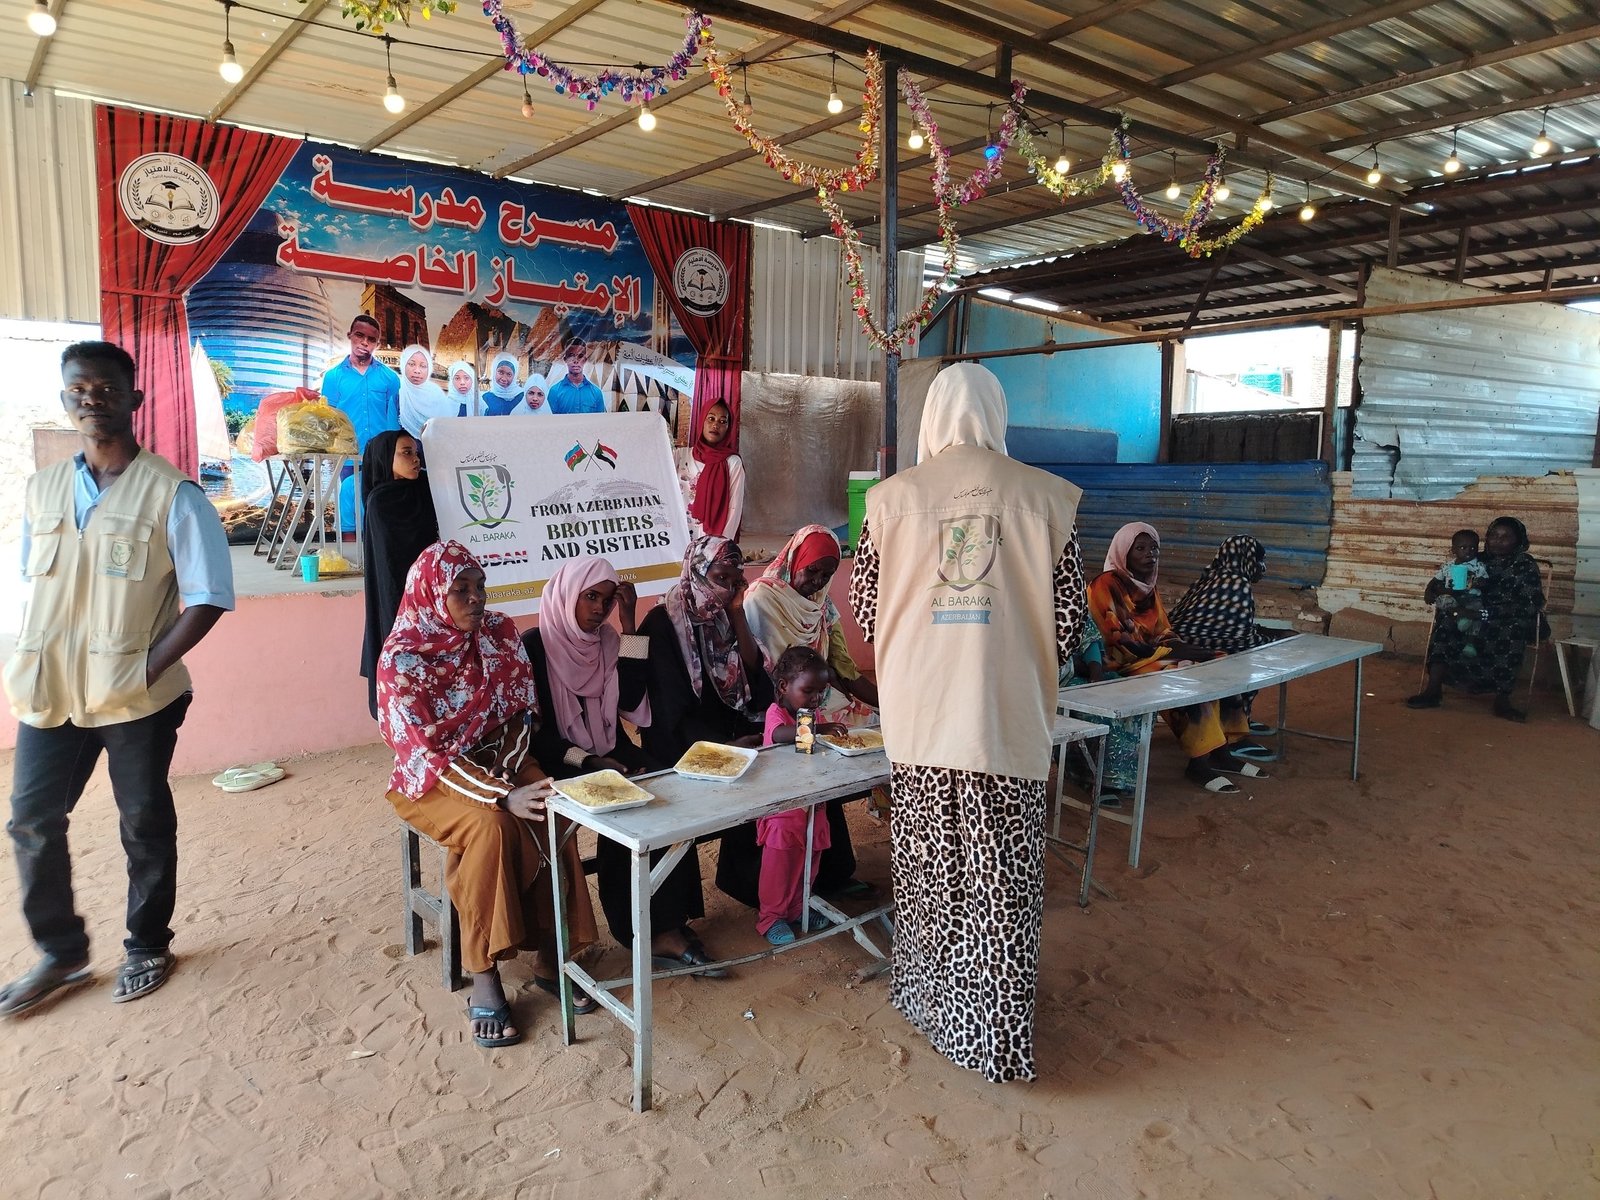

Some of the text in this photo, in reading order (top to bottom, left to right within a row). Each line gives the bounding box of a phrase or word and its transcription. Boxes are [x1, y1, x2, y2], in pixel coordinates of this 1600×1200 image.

[143, 165, 171, 177] الامتياز
[173, 166, 200, 186] مدرسة
[311, 154, 619, 252] مسرح مدرسة
[277, 222, 642, 329] الإمتياز الخاصة
[530, 494, 662, 518] FROM AZERBAIJAN
[546, 513, 654, 540] BROTHERS
[470, 531, 517, 544] AL BARAKA
[541, 530, 671, 562] AND SISTERS
[475, 550, 528, 568] UDAN
[930, 596, 992, 608] AL BARAKA
[941, 613, 981, 621] AZERBAIJAN
